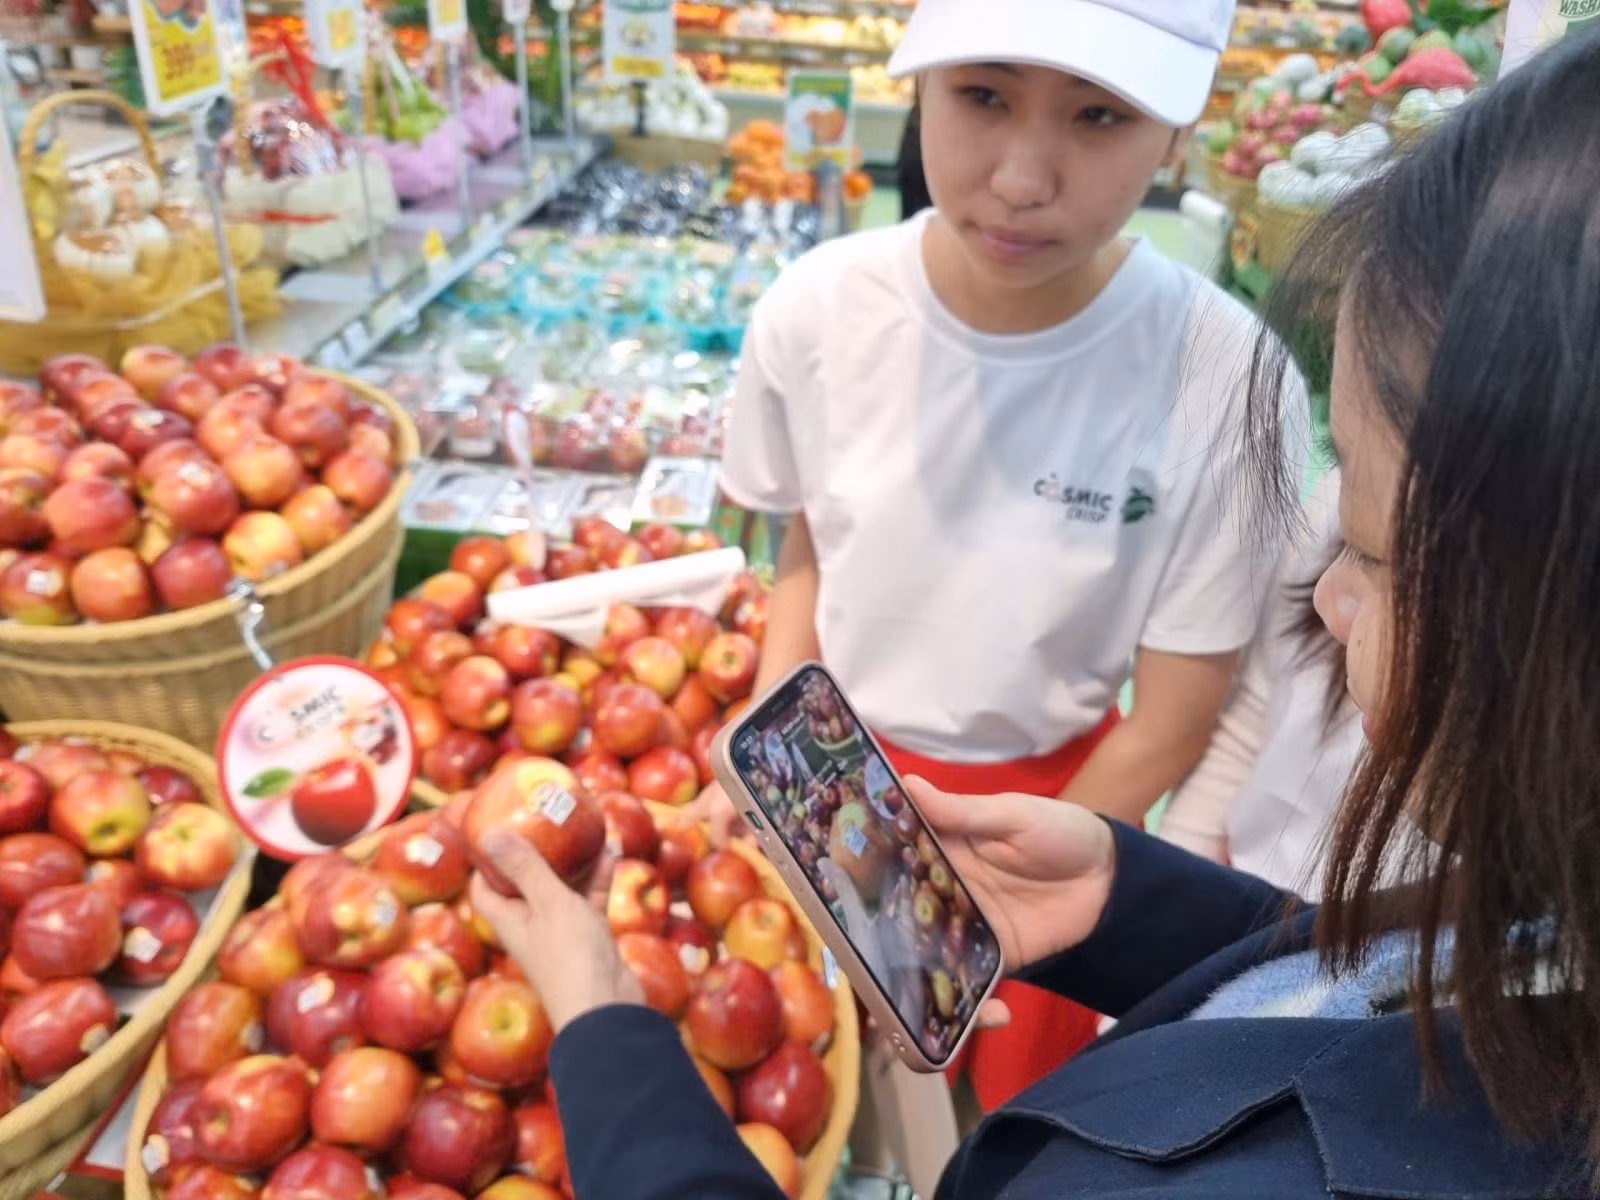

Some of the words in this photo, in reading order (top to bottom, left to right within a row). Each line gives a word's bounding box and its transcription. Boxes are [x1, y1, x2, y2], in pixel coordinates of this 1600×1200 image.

[1033, 474, 1113, 512] COSMIC
[1065, 505, 1107, 523] CRISP
[257, 685, 342, 743] CSMIC
